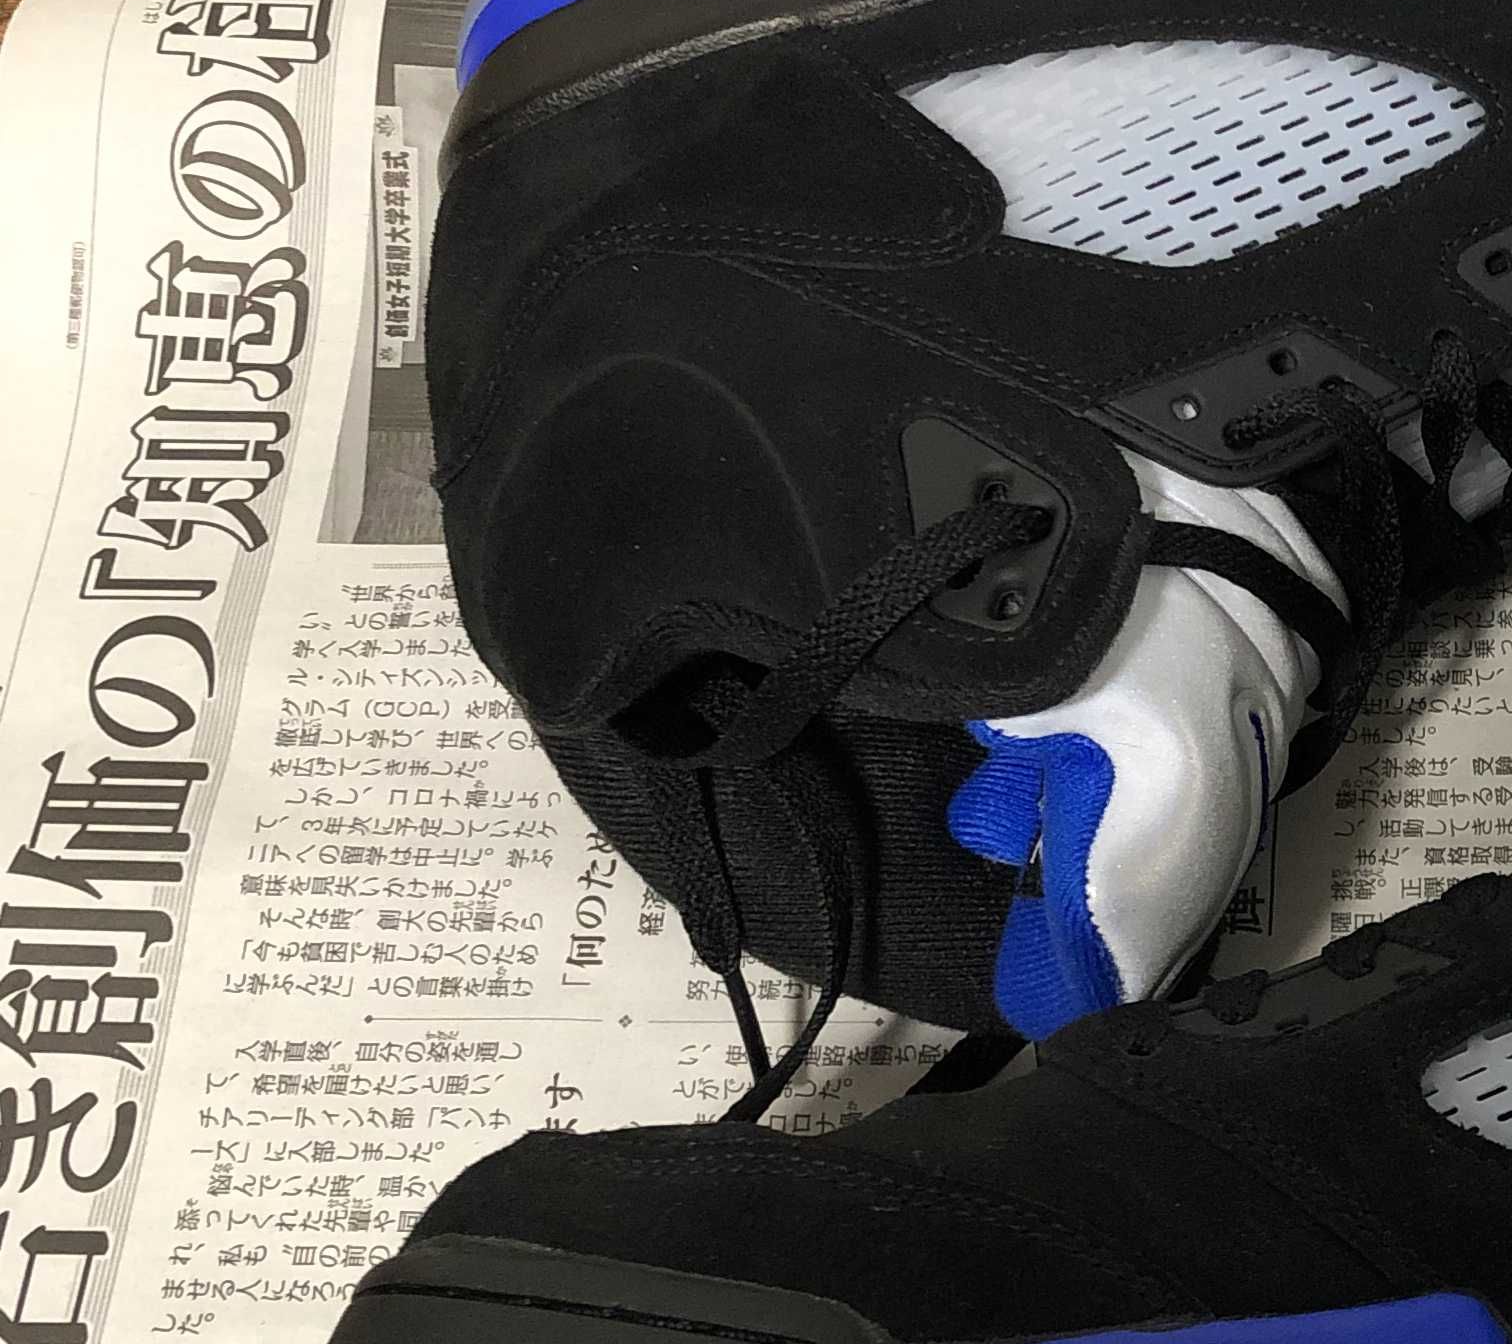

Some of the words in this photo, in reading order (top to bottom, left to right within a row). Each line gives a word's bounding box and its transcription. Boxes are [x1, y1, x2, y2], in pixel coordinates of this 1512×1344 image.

[381, 150, 412, 339] 創価女子短期大学卒業式
[287, 668, 499, 688] ル・シティズンシッ
[269, 757, 489, 778] を広げていきました。
[284, 787, 560, 808] しかし、コロナ禍によっ
[253, 814, 558, 839] て、3年次に予定していたケ
[247, 842, 554, 869] ニアへの留学は中止に。学ぶ
[241, 874, 514, 899] 意味を見失いかけました。
[258, 907, 543, 932] そんな時、創大の先輩から
[242, 938, 539, 965] 「今も貧困で苦しむ人のため
[223, 973, 534, 1000] に学ぶんだ」との言葉を掛け
[234, 1039, 523, 1064] 入学直後、自分の姿を通し
[205, 1072, 505, 1097] て、希望を届けたいと思い、
[199, 1107, 511, 1130] チアリーディング部「パンサ
[191, 1141, 446, 1163] ーズ」に入部しました。
[152, 1312, 215, 1334] した。
